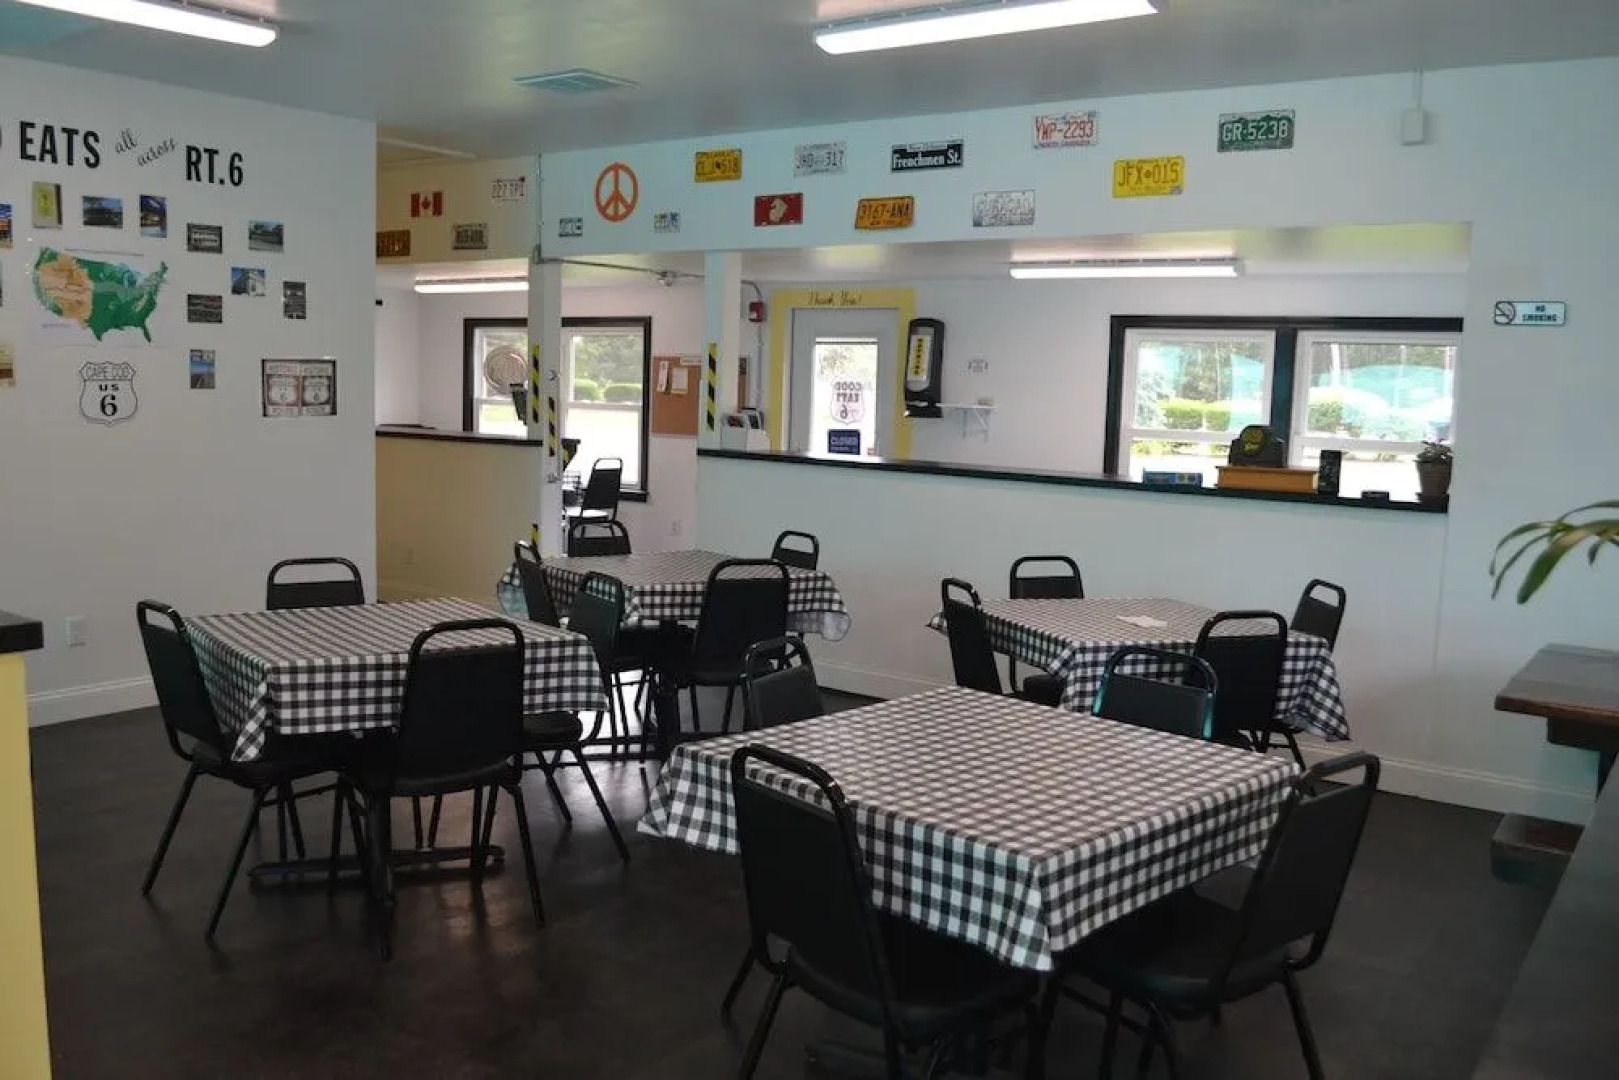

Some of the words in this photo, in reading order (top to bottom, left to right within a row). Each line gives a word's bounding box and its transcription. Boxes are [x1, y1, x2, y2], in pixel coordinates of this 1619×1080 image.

[19, 120, 101, 169] EATS
[115, 127, 138, 155] all
[137, 137, 177, 167] across
[185, 145, 245, 187] RT.6
[893, 153, 945, 169] Frenchmen
[946, 148, 963, 165] St.
[1522, 313, 1556, 322] SMOKING
[101, 393, 118, 417] 6
